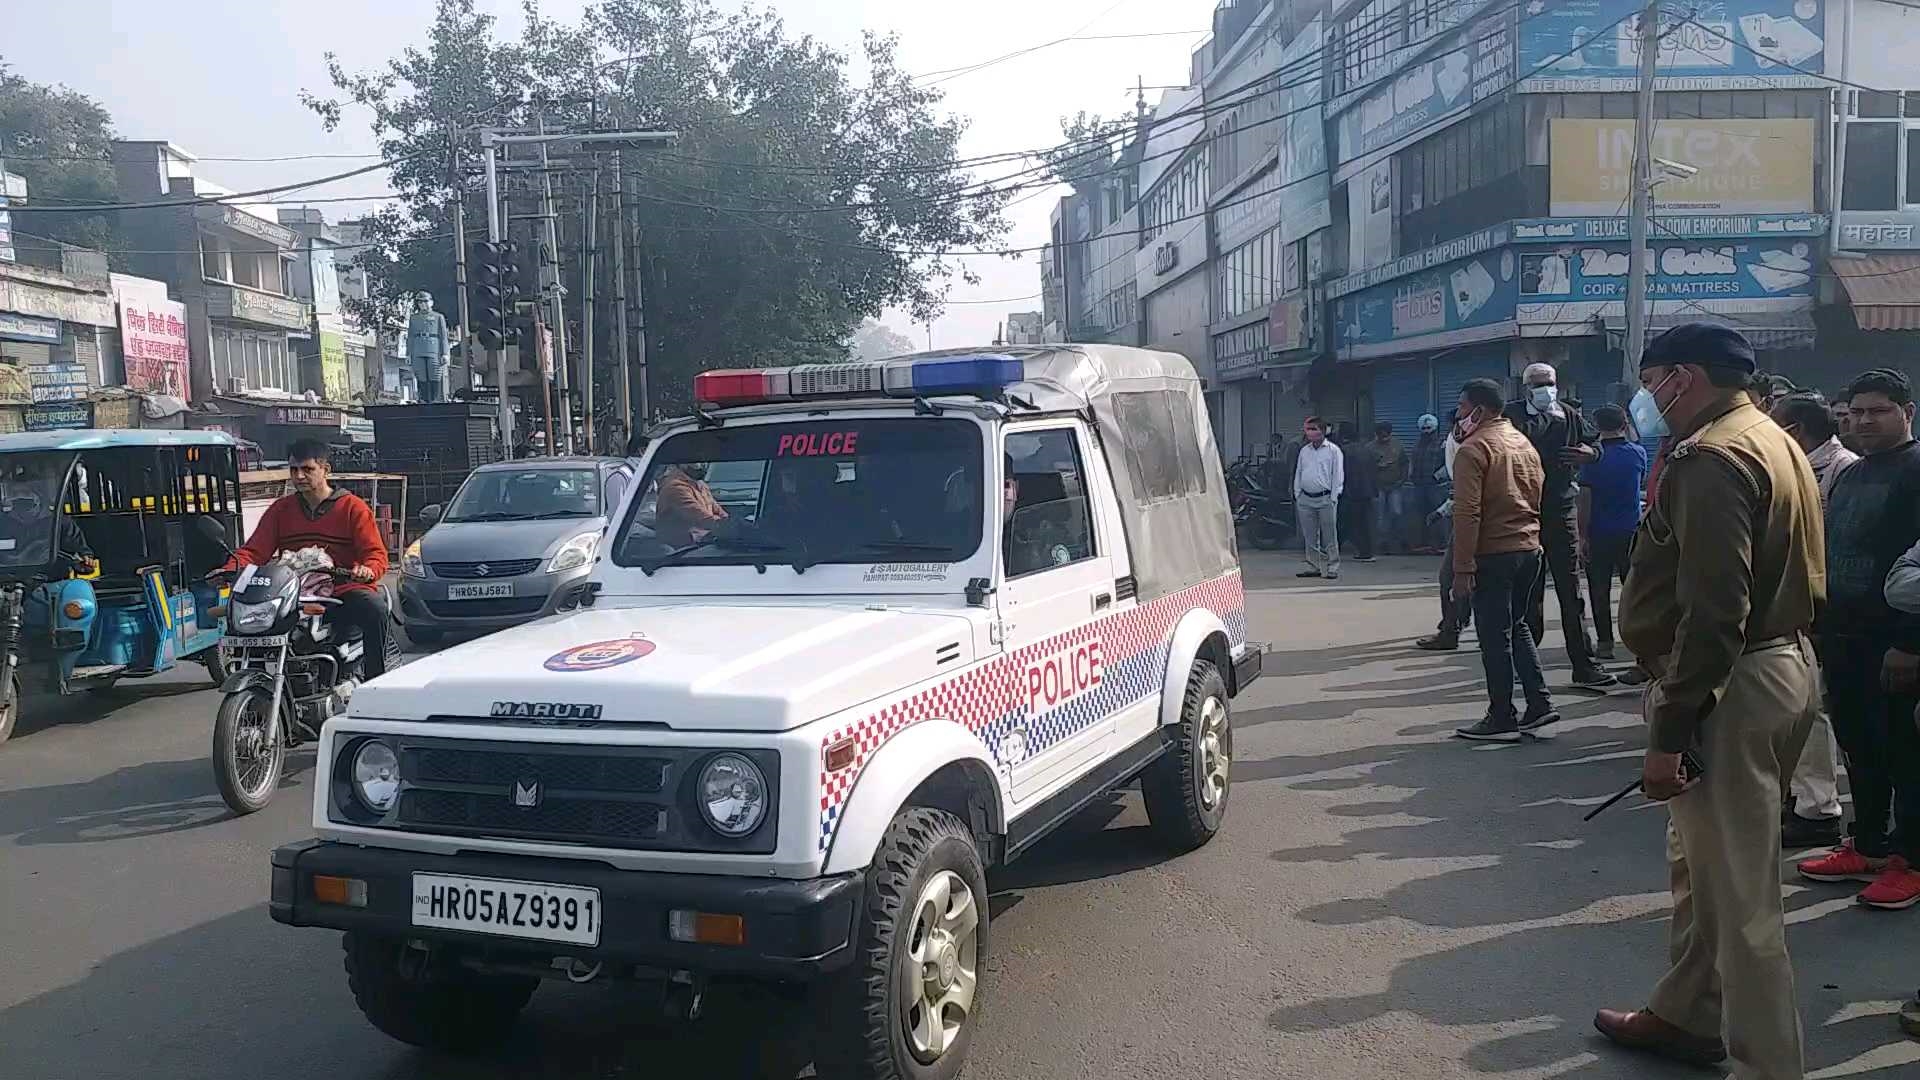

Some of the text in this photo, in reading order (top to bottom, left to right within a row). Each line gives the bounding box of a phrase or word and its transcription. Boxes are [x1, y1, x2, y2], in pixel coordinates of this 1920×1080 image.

[1585, 219, 1627, 237] DELUXE
[1697, 217, 1752, 235] EMPORIUM
[1844, 219, 1914, 244] महादेव
[1335, 231, 1491, 297] DELUXE HANDLOOM EMPORIUM
[1582, 283, 1616, 296] COIR
[1671, 281, 1740, 293] MATTRESS
[777, 431, 859, 456] POLICE
[1028, 641, 1101, 714] POLICE
[490, 702, 604, 720] MARUTI
[430, 884, 594, 934] HR05AZ9391
